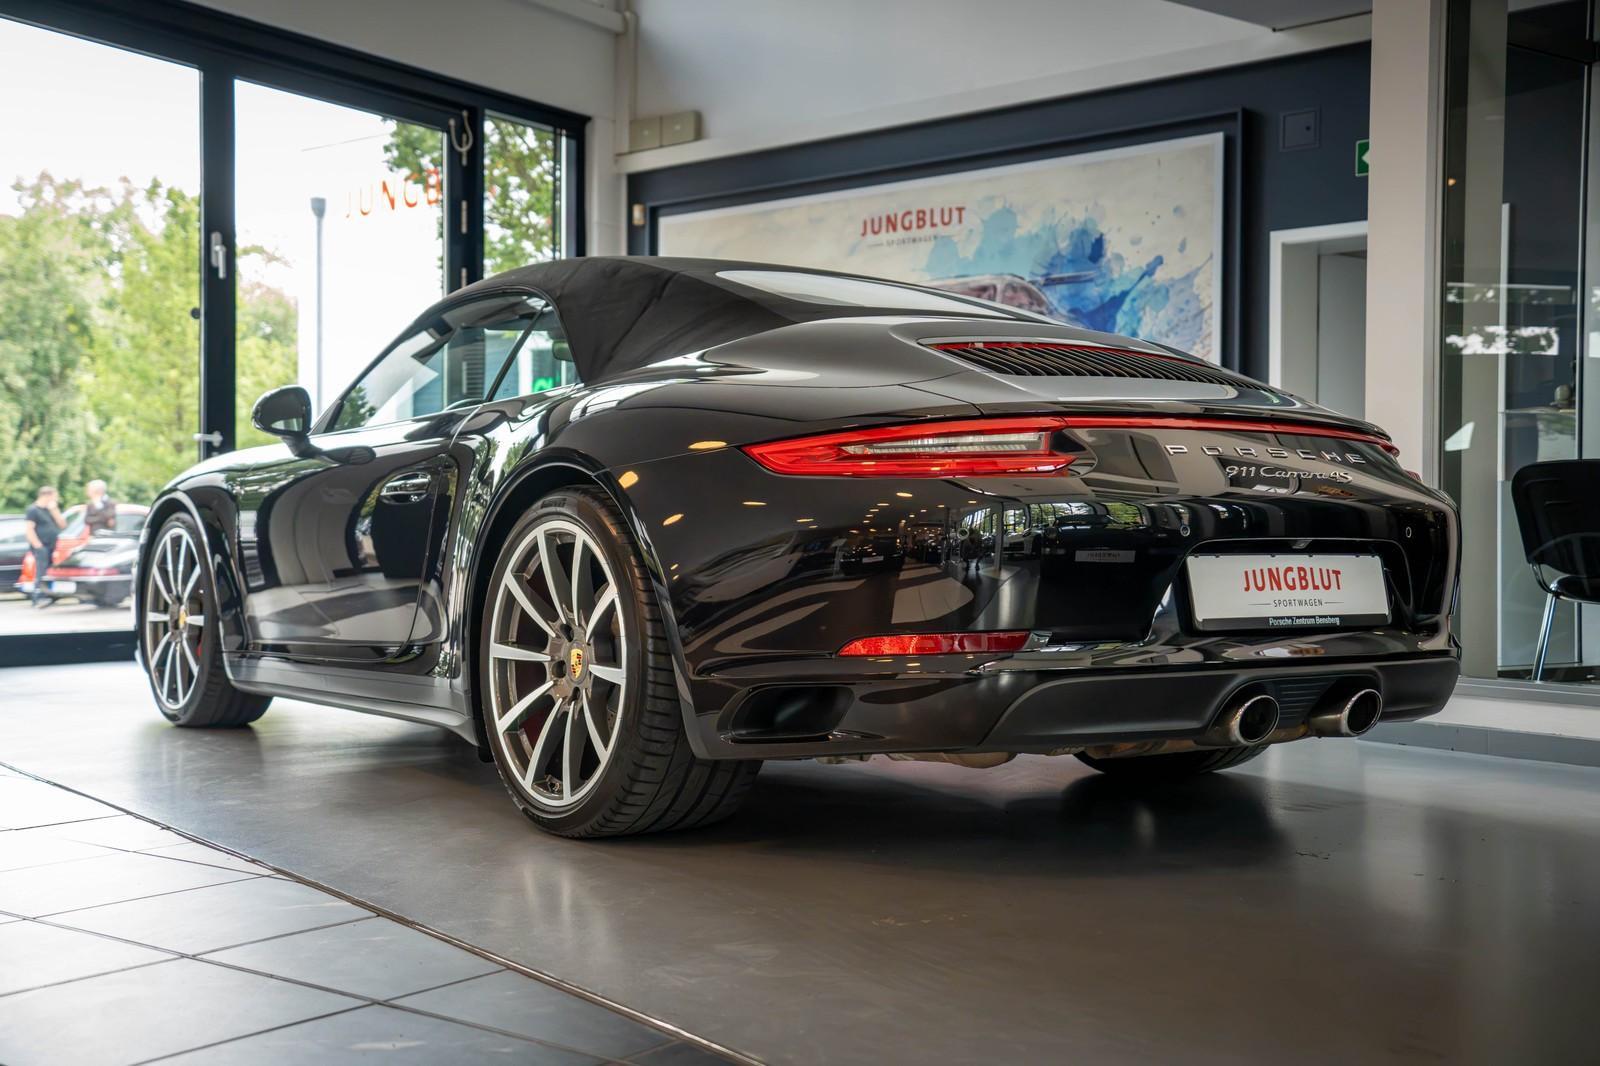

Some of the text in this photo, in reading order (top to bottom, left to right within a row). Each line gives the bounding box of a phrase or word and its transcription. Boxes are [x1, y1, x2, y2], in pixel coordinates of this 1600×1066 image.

[345, 167, 443, 219] JUNGB
[860, 207, 966, 237] JUNGBLUT
[1164, 445, 1367, 465] PORSCHE
[1225, 465, 1353, 484] 911 Carrera 4S
[1243, 566, 1342, 592] JUNGBLUT
[1273, 599, 1324, 608] SPORTWAGEN
[1269, 616, 1340, 626] Porsche Zentrum Bensberg
